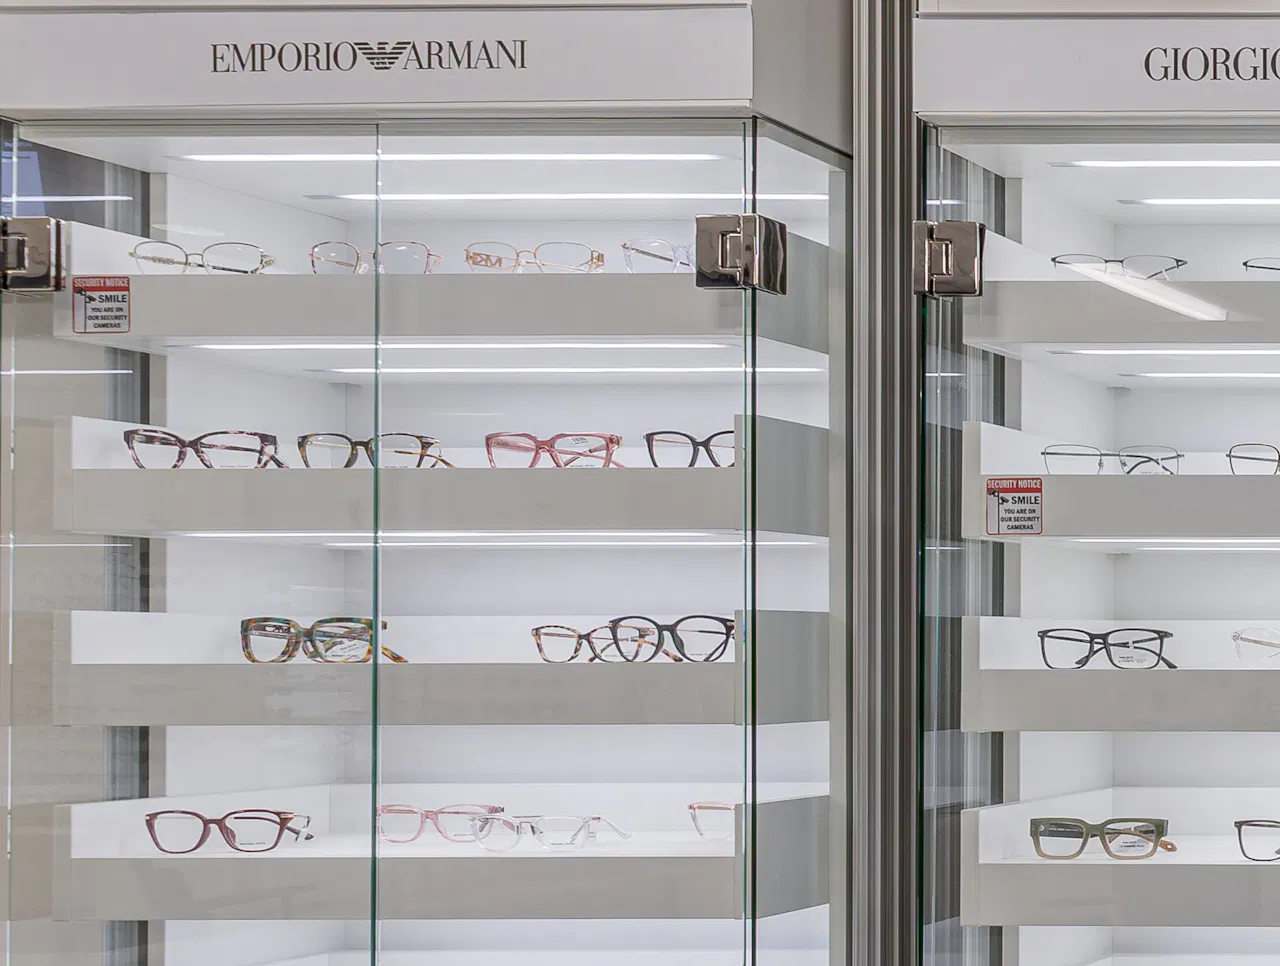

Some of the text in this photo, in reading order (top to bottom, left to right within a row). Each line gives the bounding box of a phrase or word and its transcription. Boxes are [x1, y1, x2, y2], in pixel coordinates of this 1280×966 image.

[211, 40, 527, 73] EMPORIO ARMANI
[74, 278, 128, 287] SECURITY NOTICE
[98, 294, 127, 303] SMILE
[987, 479, 1041, 489] SECURITY NOTICE
[1011, 496, 1040, 505] SMILE
